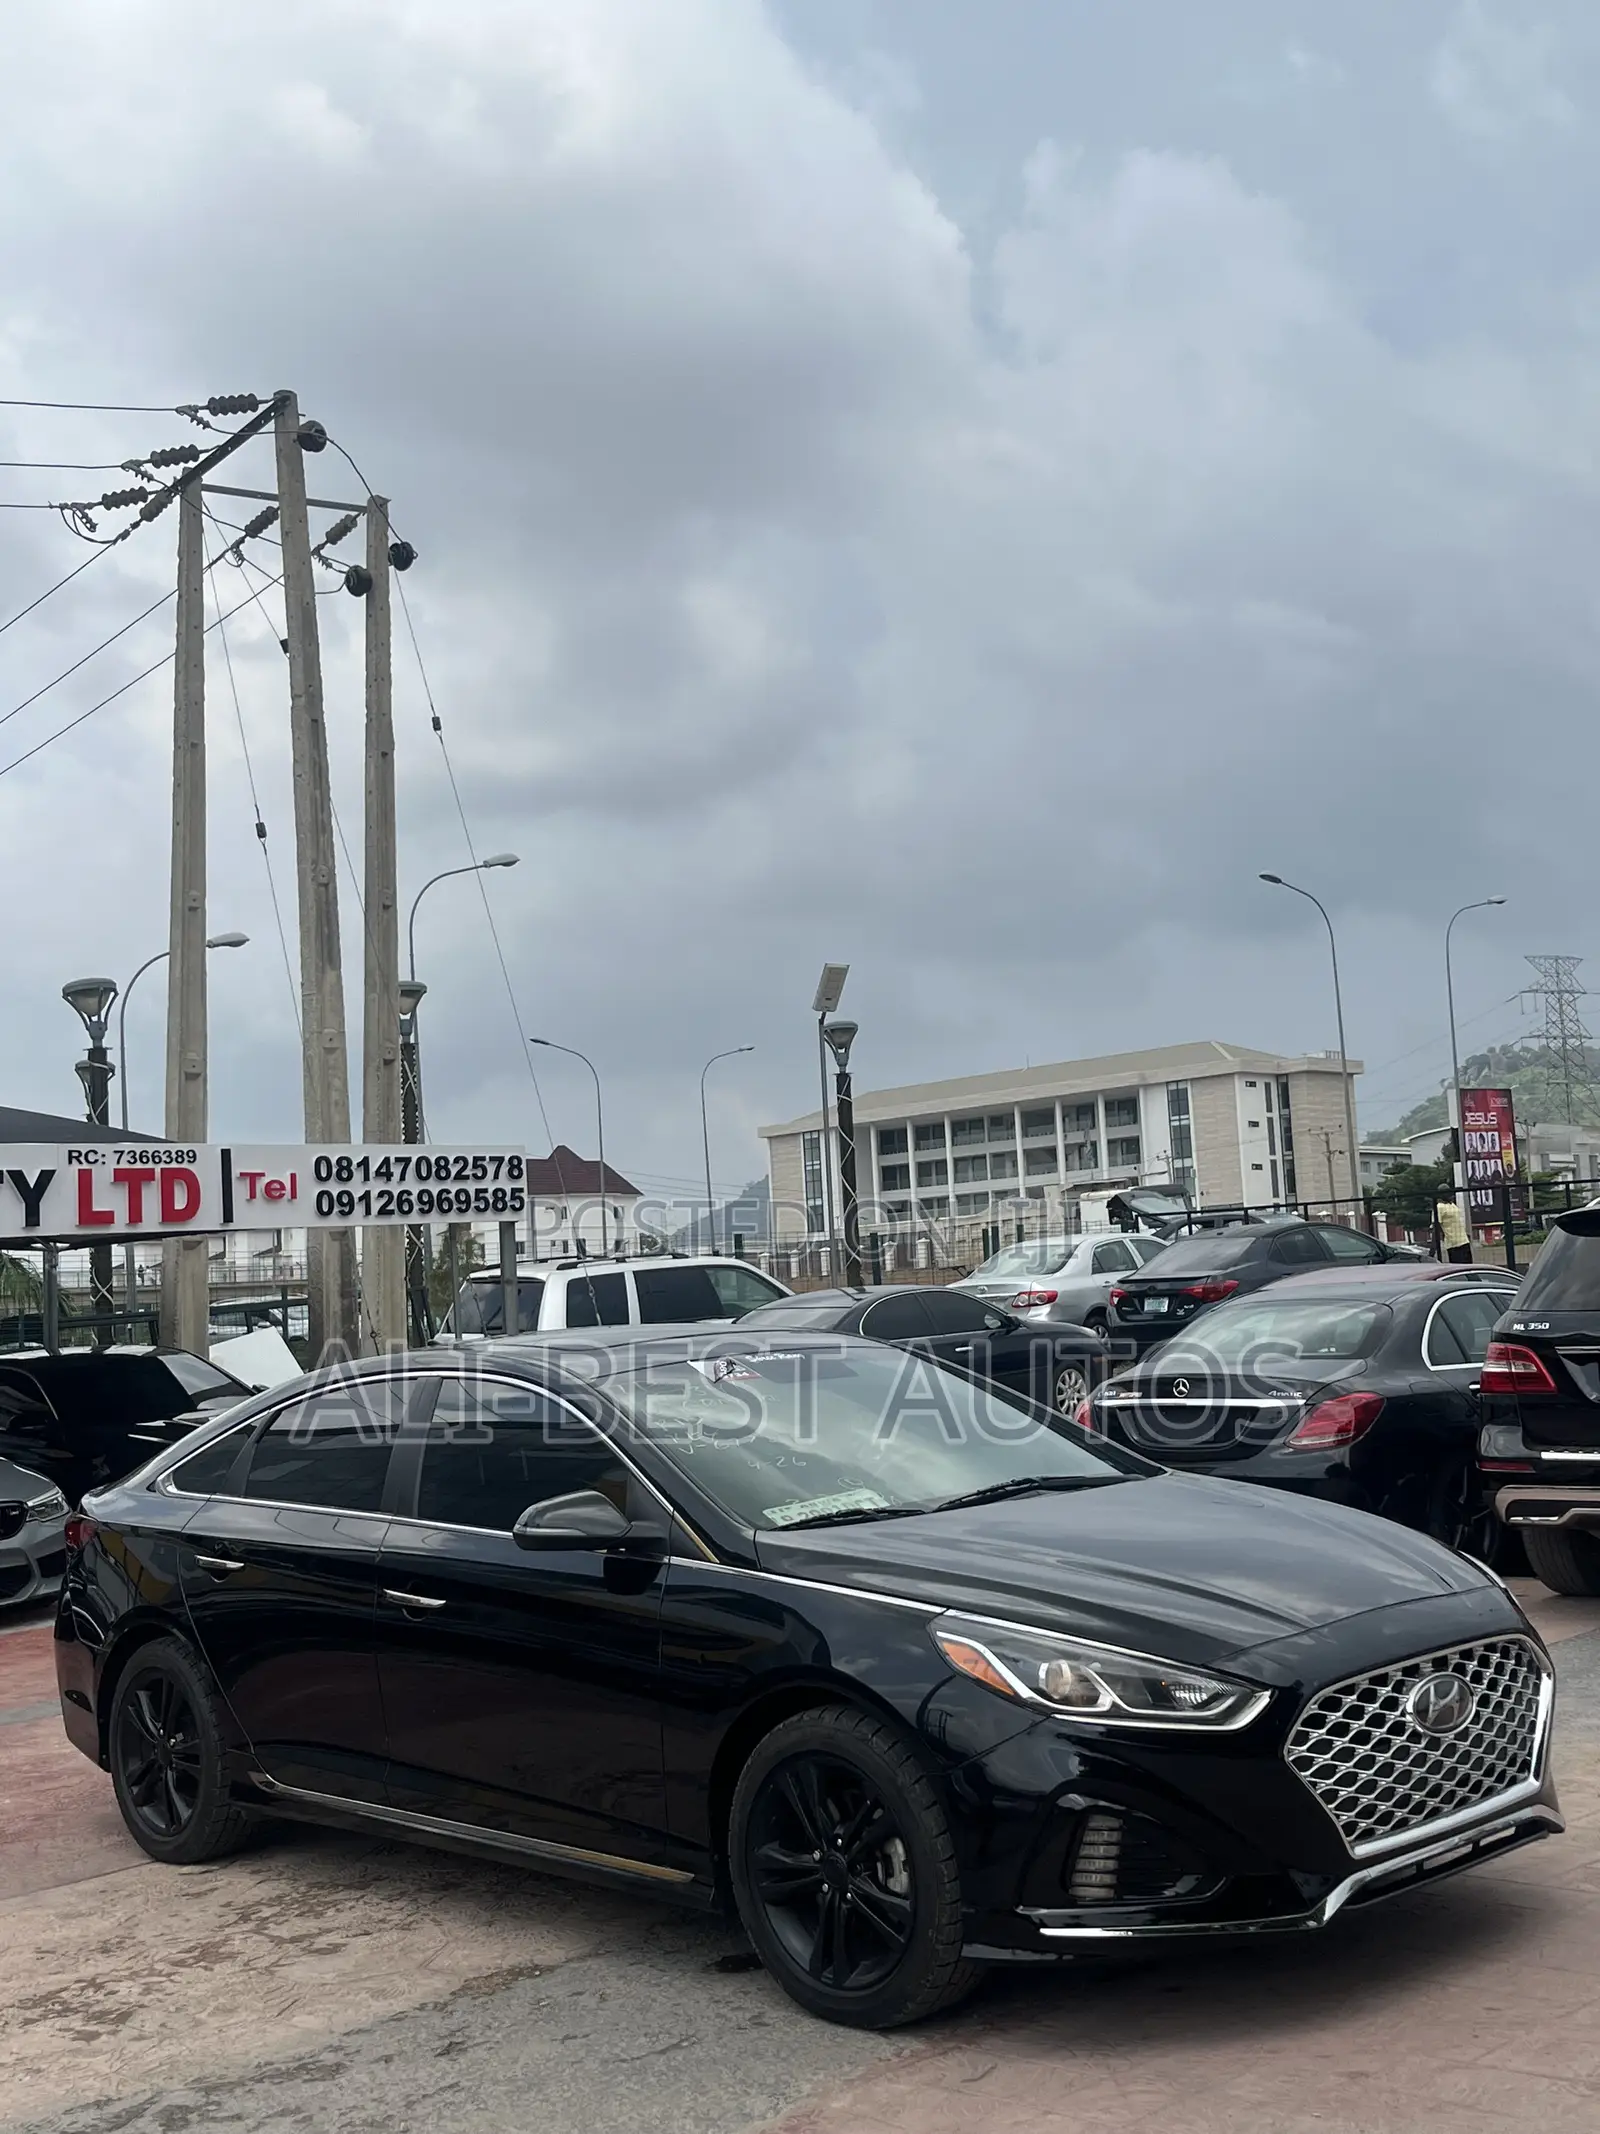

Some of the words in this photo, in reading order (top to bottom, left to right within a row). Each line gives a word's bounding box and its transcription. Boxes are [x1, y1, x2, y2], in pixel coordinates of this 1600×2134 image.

[1464, 1111, 1498, 1126] JESUS
[67, 1149, 106, 1166] RC:
[113, 1149, 198, 1166] 7366389
[313, 1154, 525, 1184] 08147082578
[77, 1166, 202, 1226] LTD
[239, 1170, 298, 1201] Tel
[315, 1186, 526, 1218] 09126969585
[1512, 1322, 1527, 1331] ML
[1527, 1321, 1551, 1331] 350
